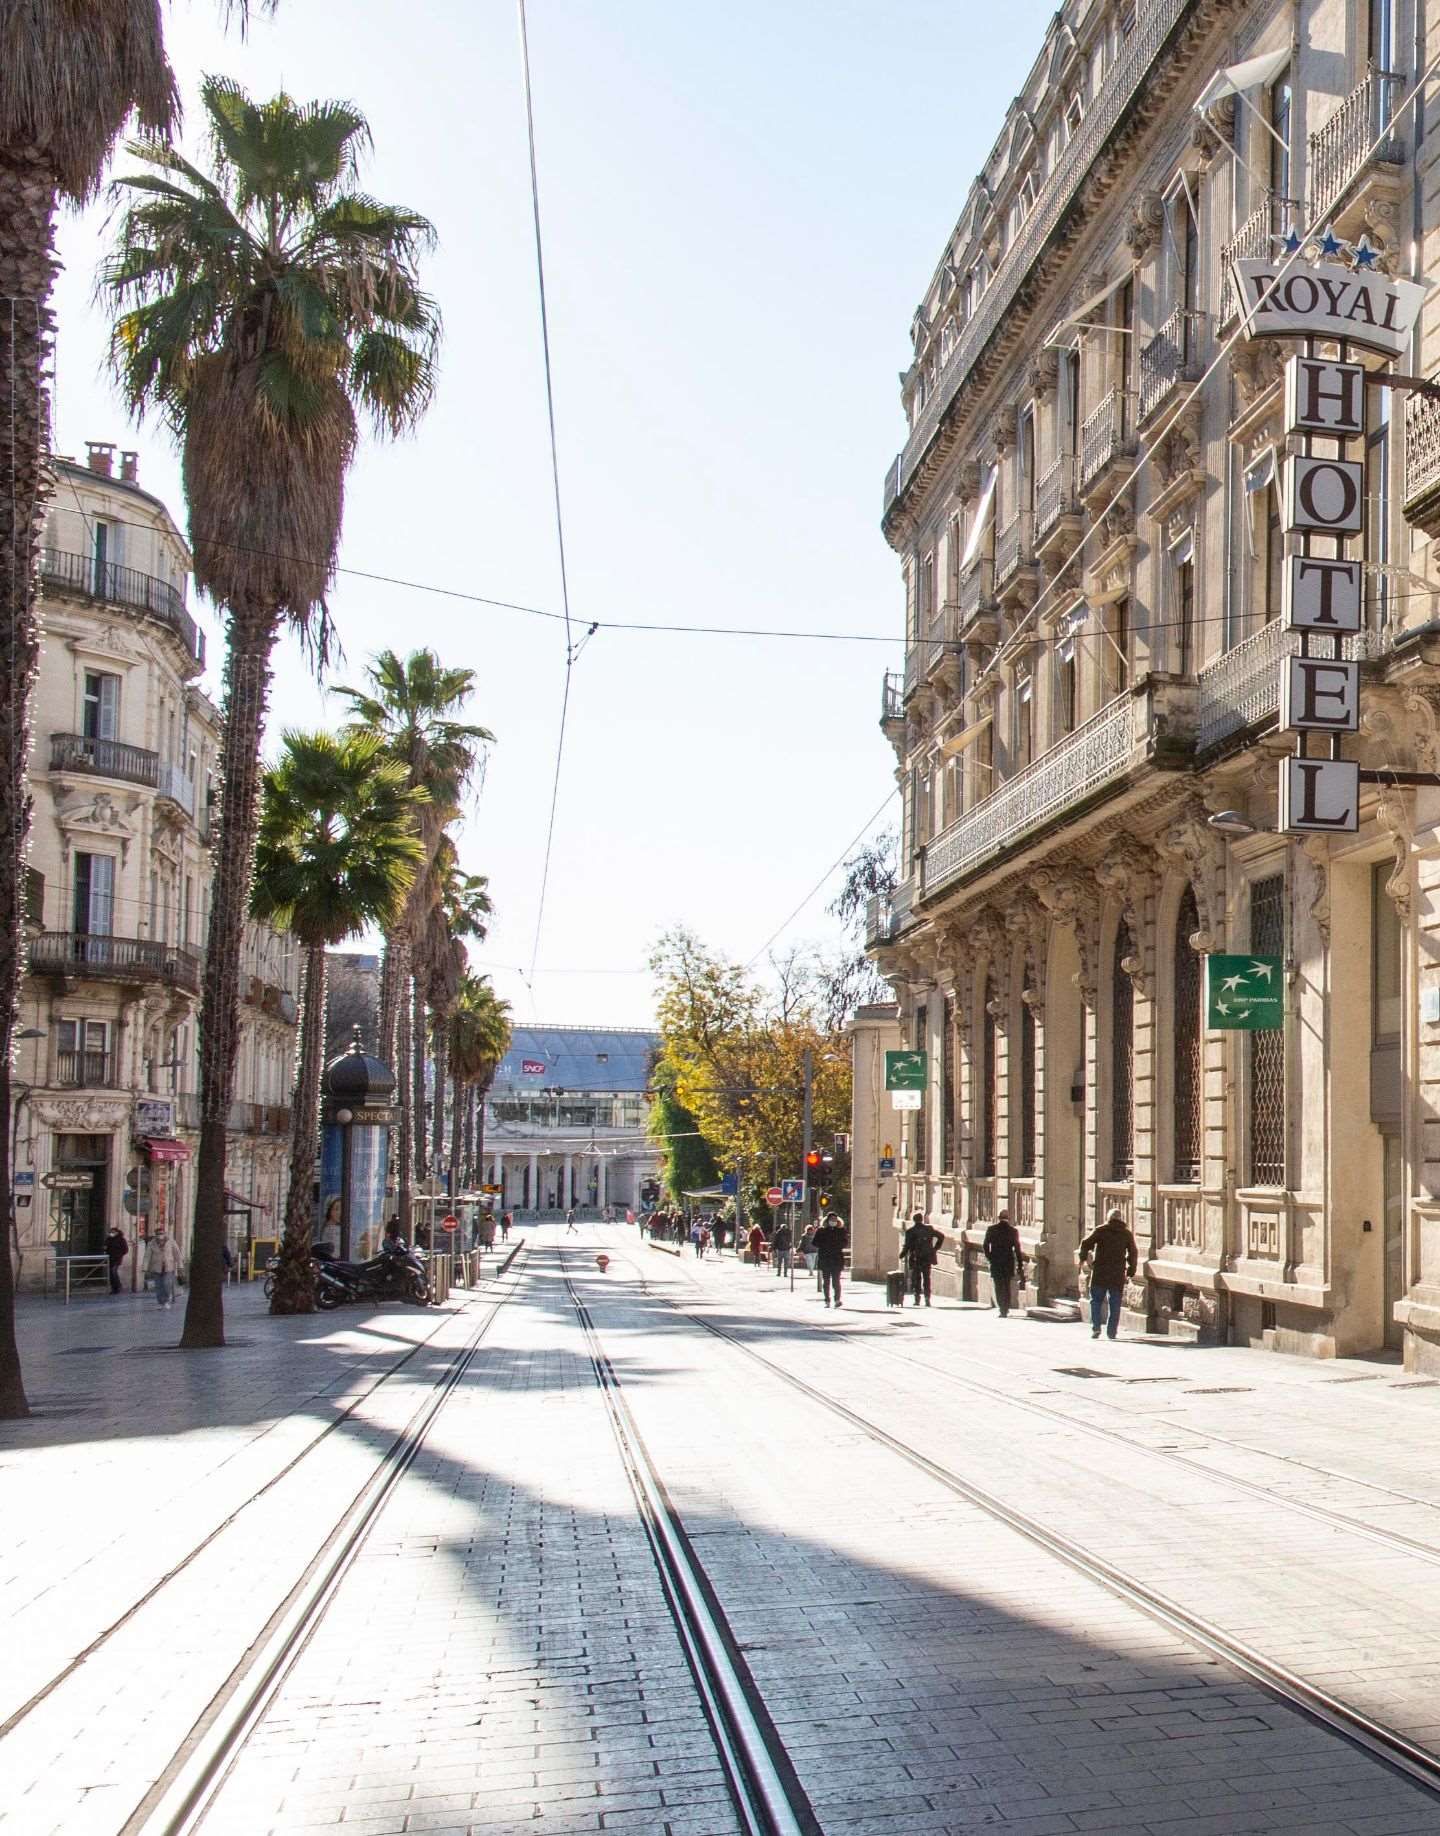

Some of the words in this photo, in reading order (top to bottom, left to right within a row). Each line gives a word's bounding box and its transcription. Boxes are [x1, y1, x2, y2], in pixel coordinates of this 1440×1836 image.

[1250, 274, 1408, 334] ROYAL
[1298, 363, 1361, 827] HOTEL
[523, 1064, 545, 1073] SNCF
